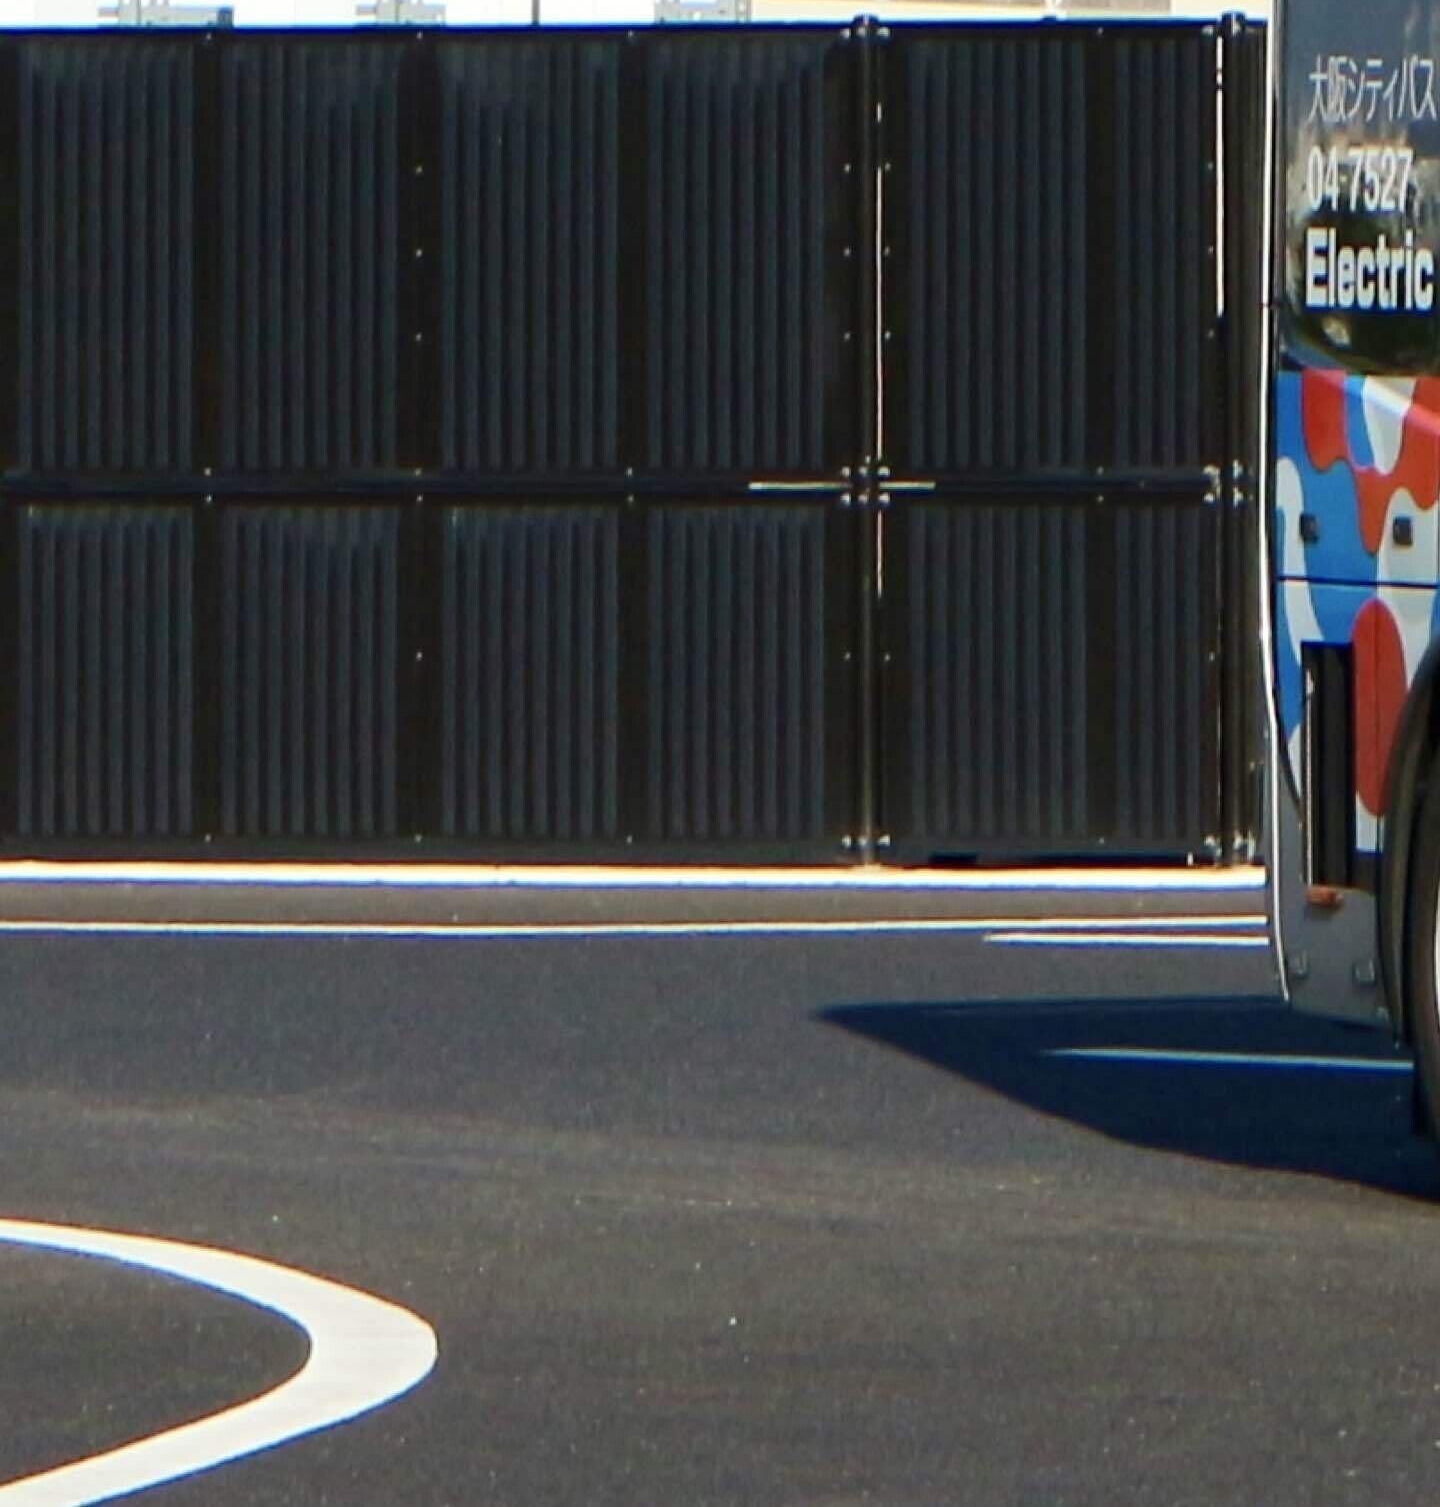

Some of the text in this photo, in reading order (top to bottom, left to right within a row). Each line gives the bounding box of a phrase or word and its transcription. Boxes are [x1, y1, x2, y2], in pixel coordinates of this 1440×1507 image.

[1306, 53, 1438, 122] 大阪シティバス
[1306, 144, 1415, 214] 04-7527
[1304, 227, 1435, 310] Electric
